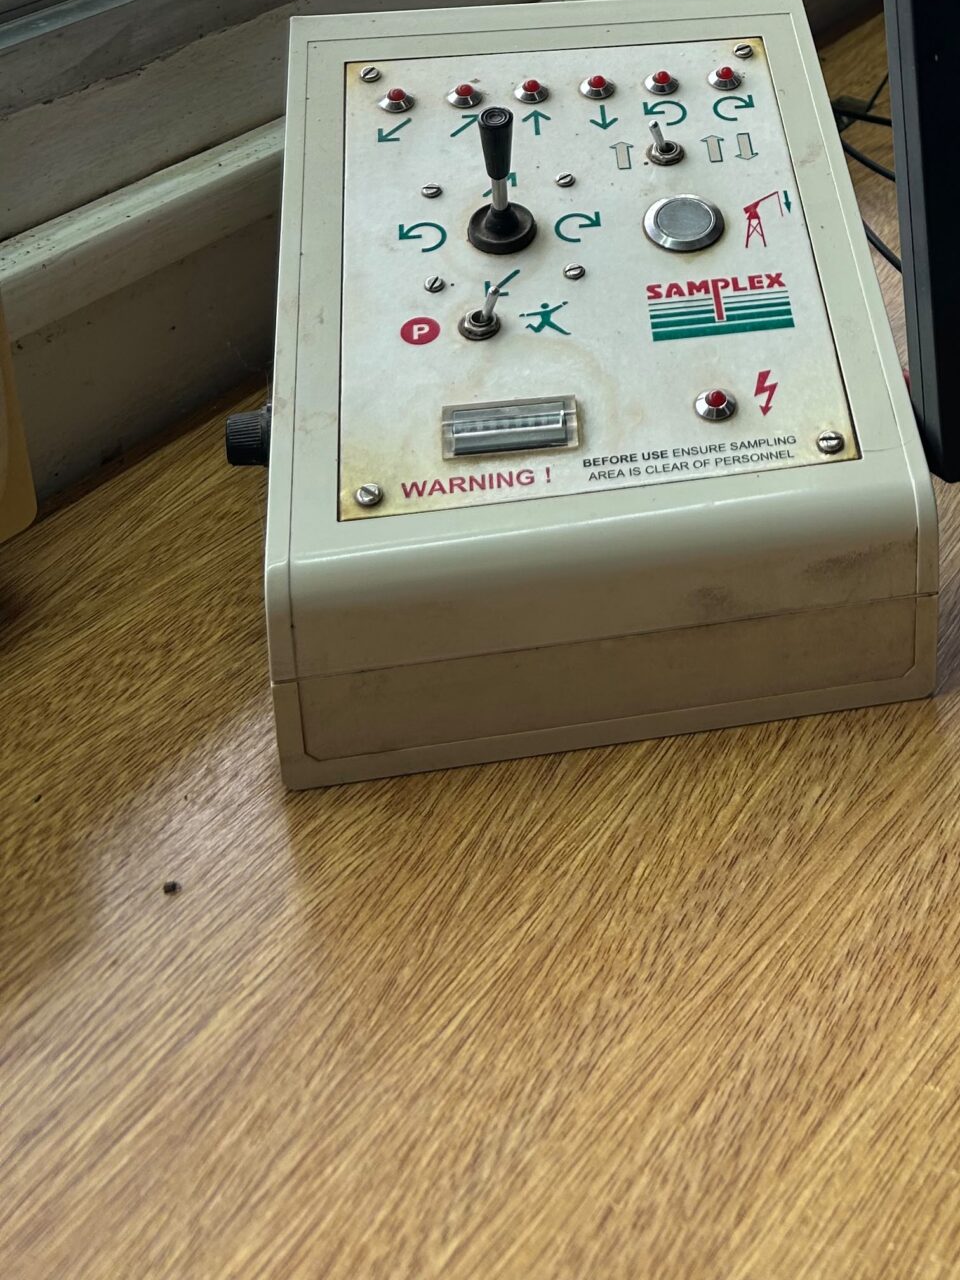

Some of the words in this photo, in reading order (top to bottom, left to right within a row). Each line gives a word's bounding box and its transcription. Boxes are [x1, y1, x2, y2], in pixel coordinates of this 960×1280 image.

[646, 272, 786, 321] SAMPLEX
[412, 323, 429, 341] P
[583, 453, 638, 468] BEFORE
[642, 450, 669, 461] USE
[672, 443, 727, 458] ENSURE
[730, 435, 797, 451] SAMPLING
[588, 468, 626, 481] AREA
[629, 467, 642, 477] IS
[645, 461, 690, 475] CLEAR
[692, 459, 711, 469] OF
[714, 450, 795, 466] PERSONNEL
[401, 469, 535, 498] WARNING
